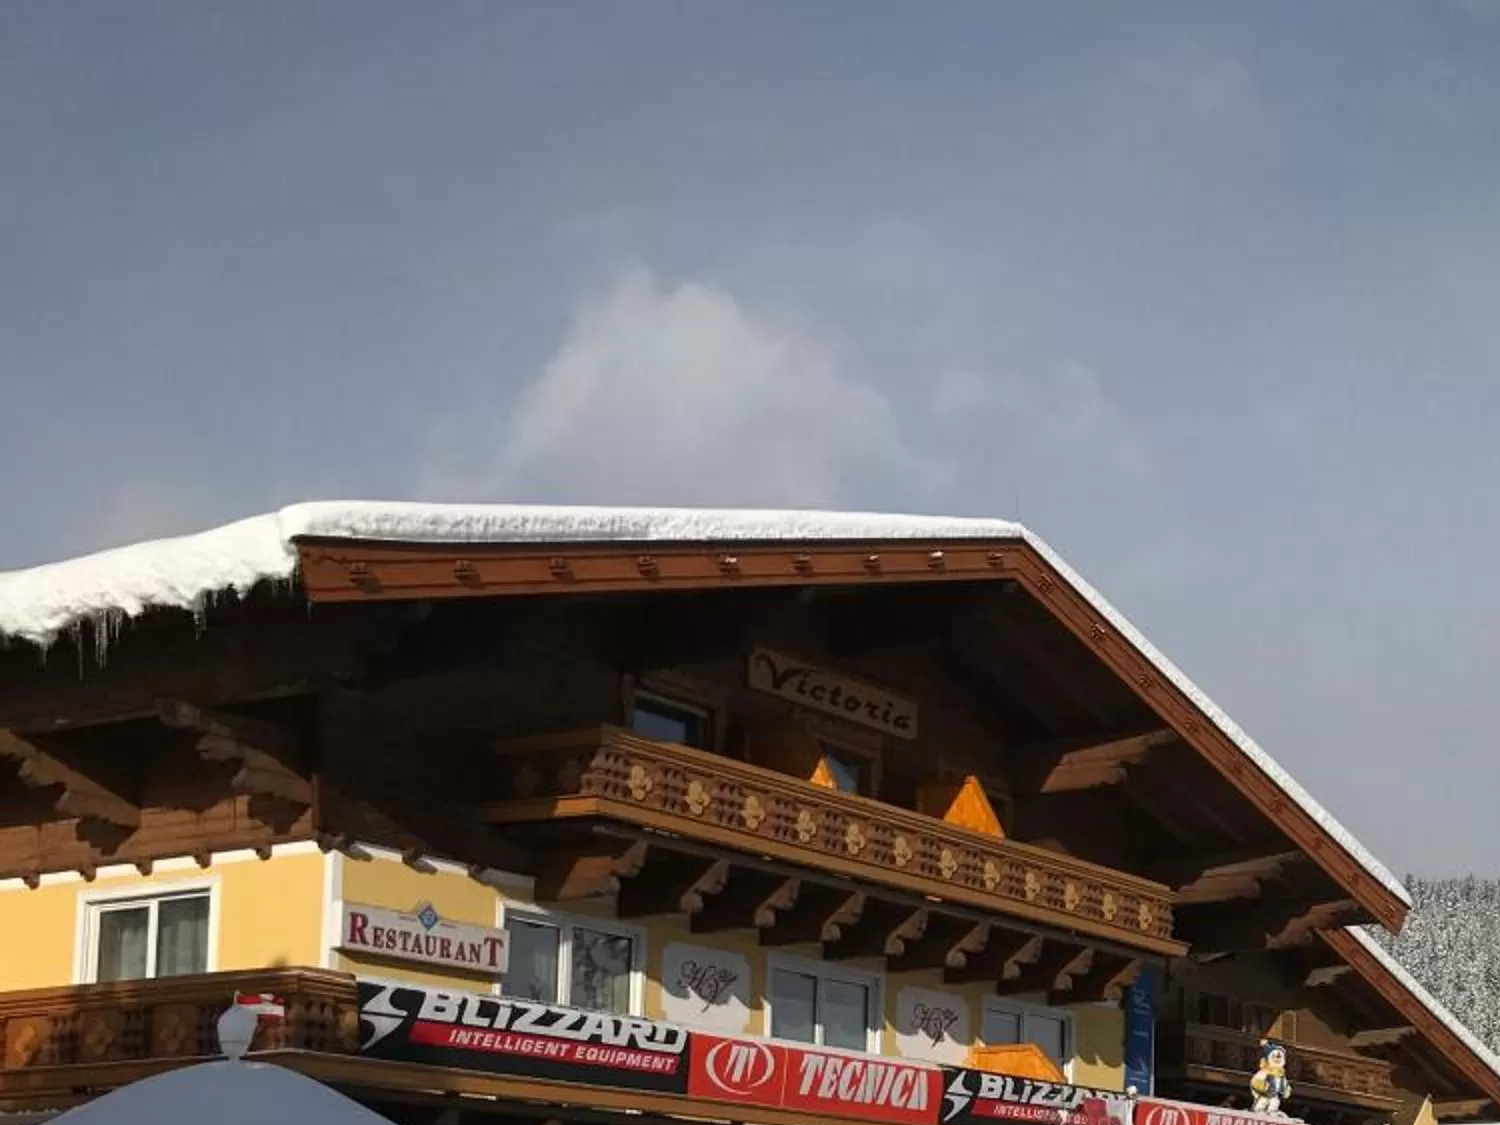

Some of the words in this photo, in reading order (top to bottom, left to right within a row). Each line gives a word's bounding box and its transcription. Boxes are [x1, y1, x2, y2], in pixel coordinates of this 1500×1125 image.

[755, 653, 912, 730] Victoria
[348, 911, 505, 967] RESTAURANT
[448, 1028, 570, 1058] INTELLIGENT
[575, 1045, 675, 1072] EQUIPMENT
[799, 1053, 928, 1111] TECNICA
